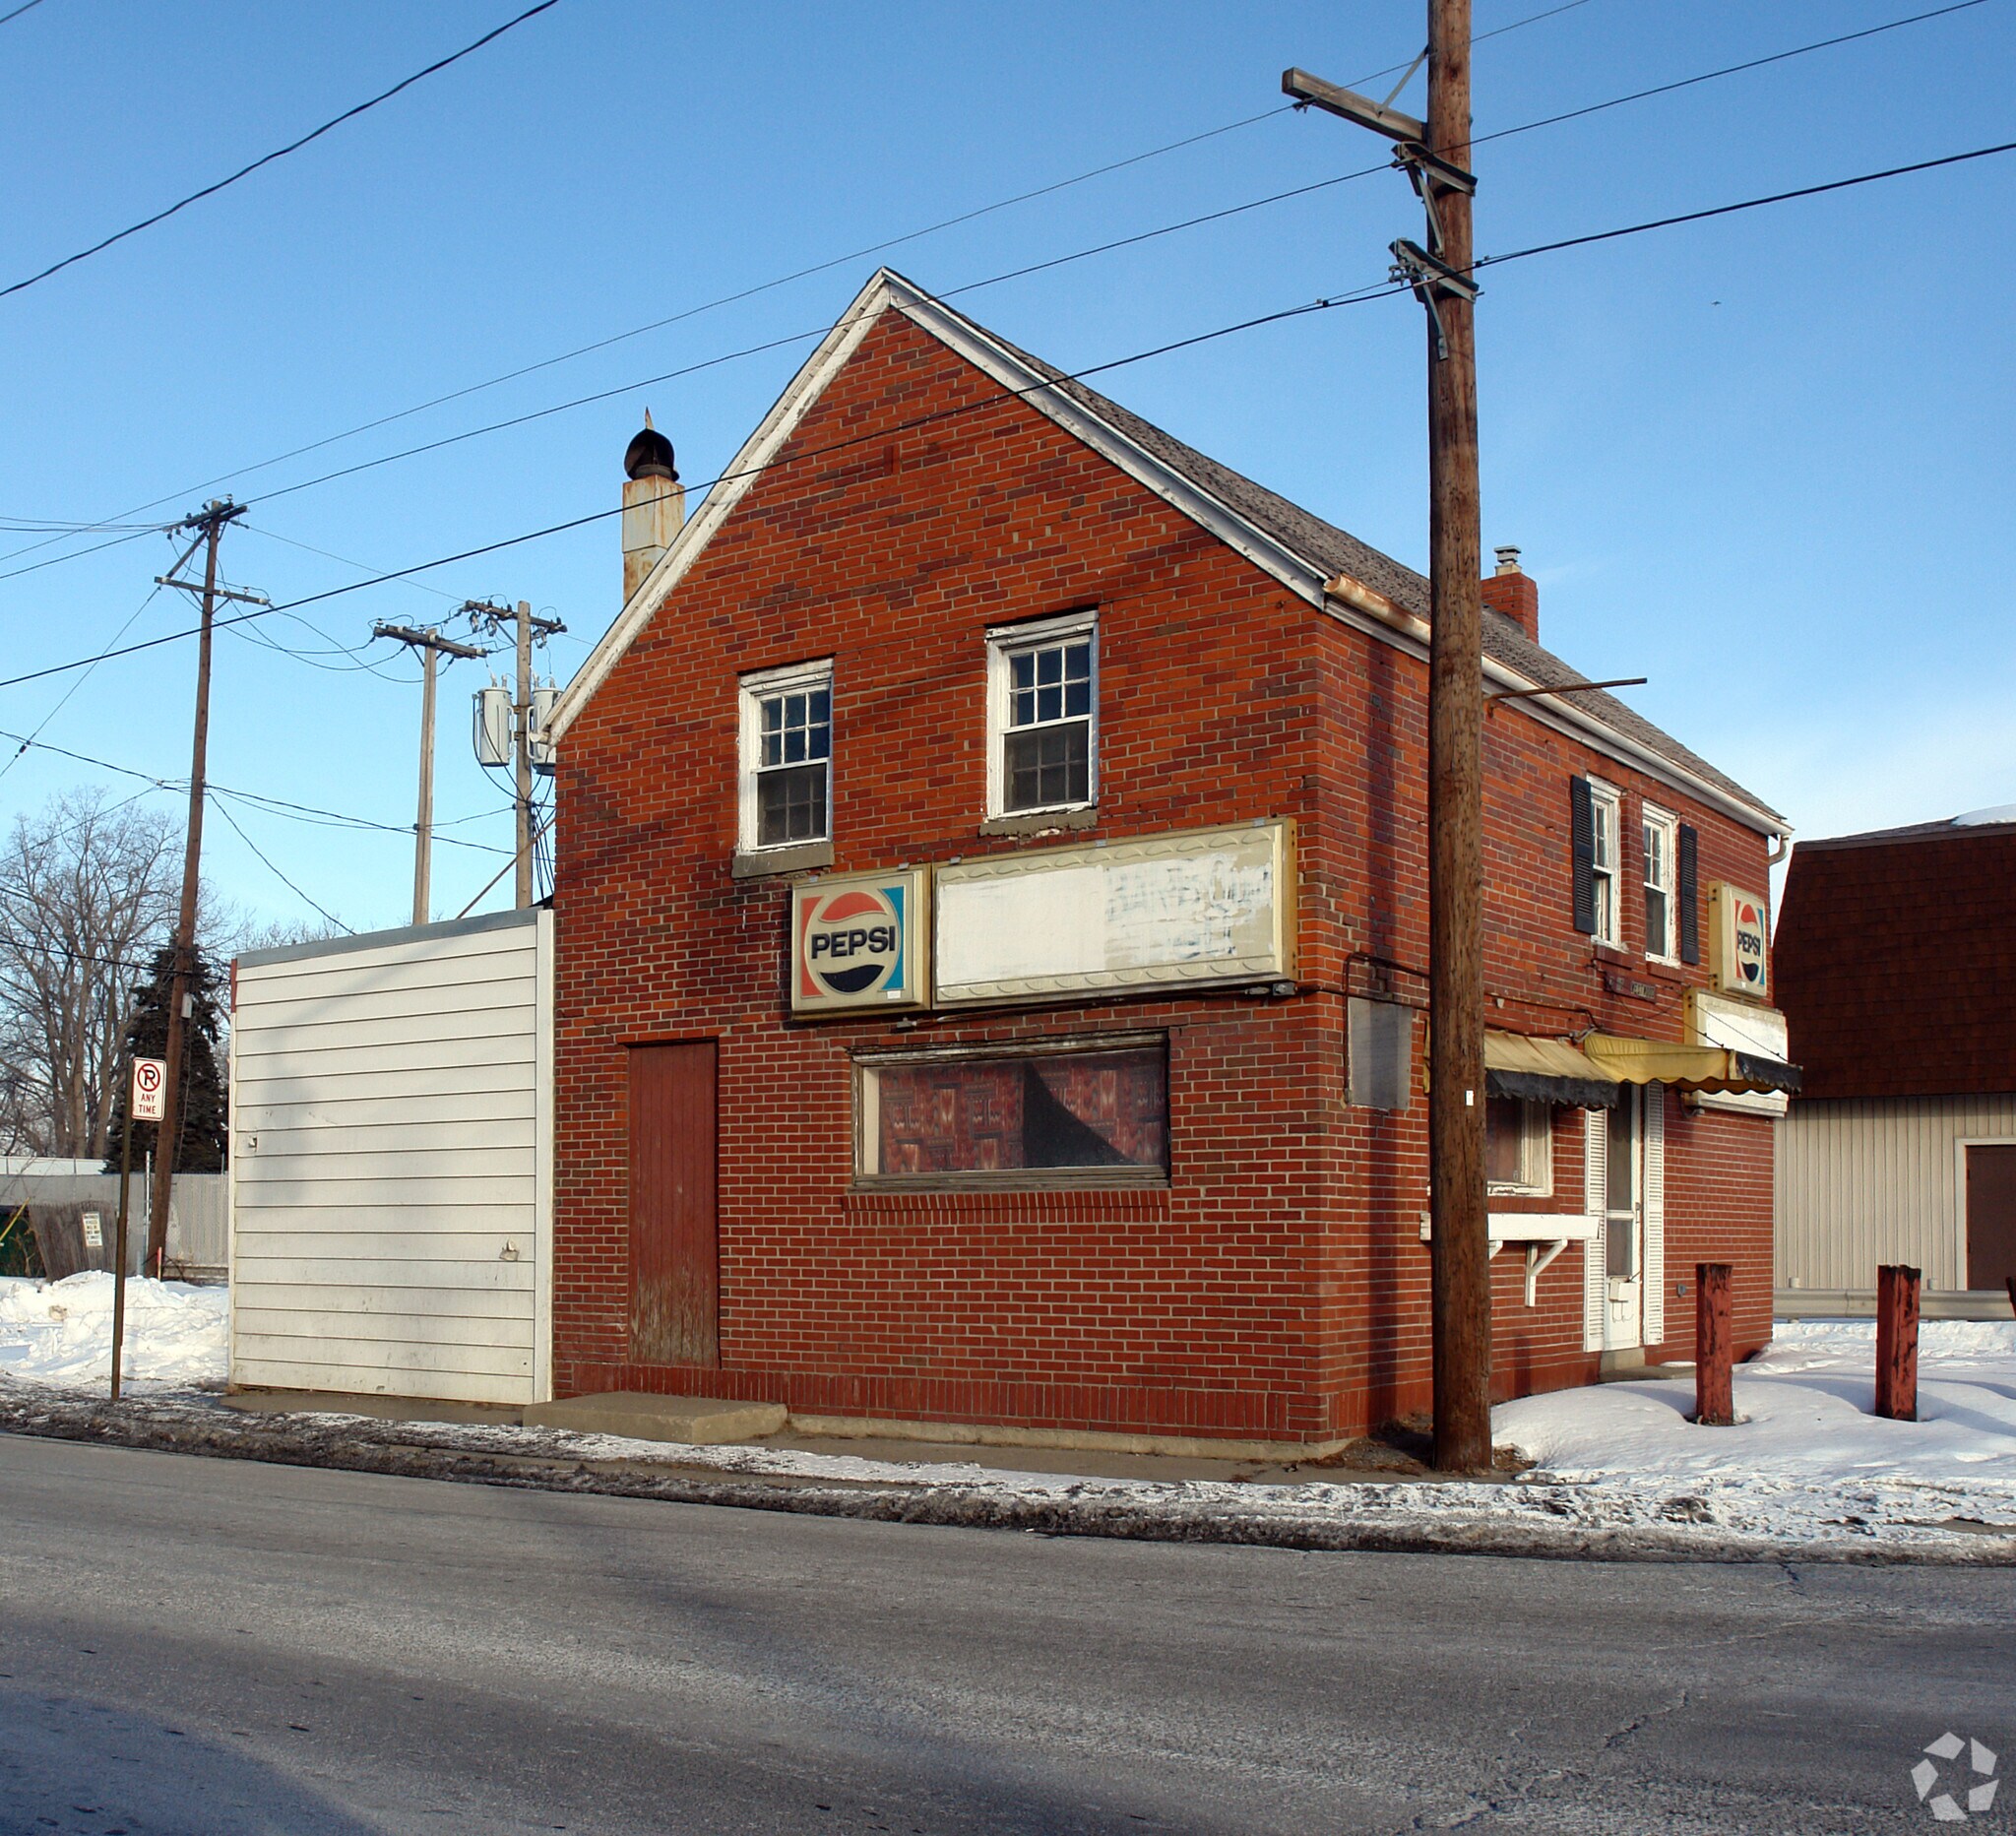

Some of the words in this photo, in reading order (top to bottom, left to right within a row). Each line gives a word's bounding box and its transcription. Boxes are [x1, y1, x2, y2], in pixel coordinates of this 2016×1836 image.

[811, 925, 895, 959] PEPSI
[1736, 929, 1760, 957] PEPSI
[141, 1093, 156, 1104] ANY
[139, 1104, 157, 1114] TIME
